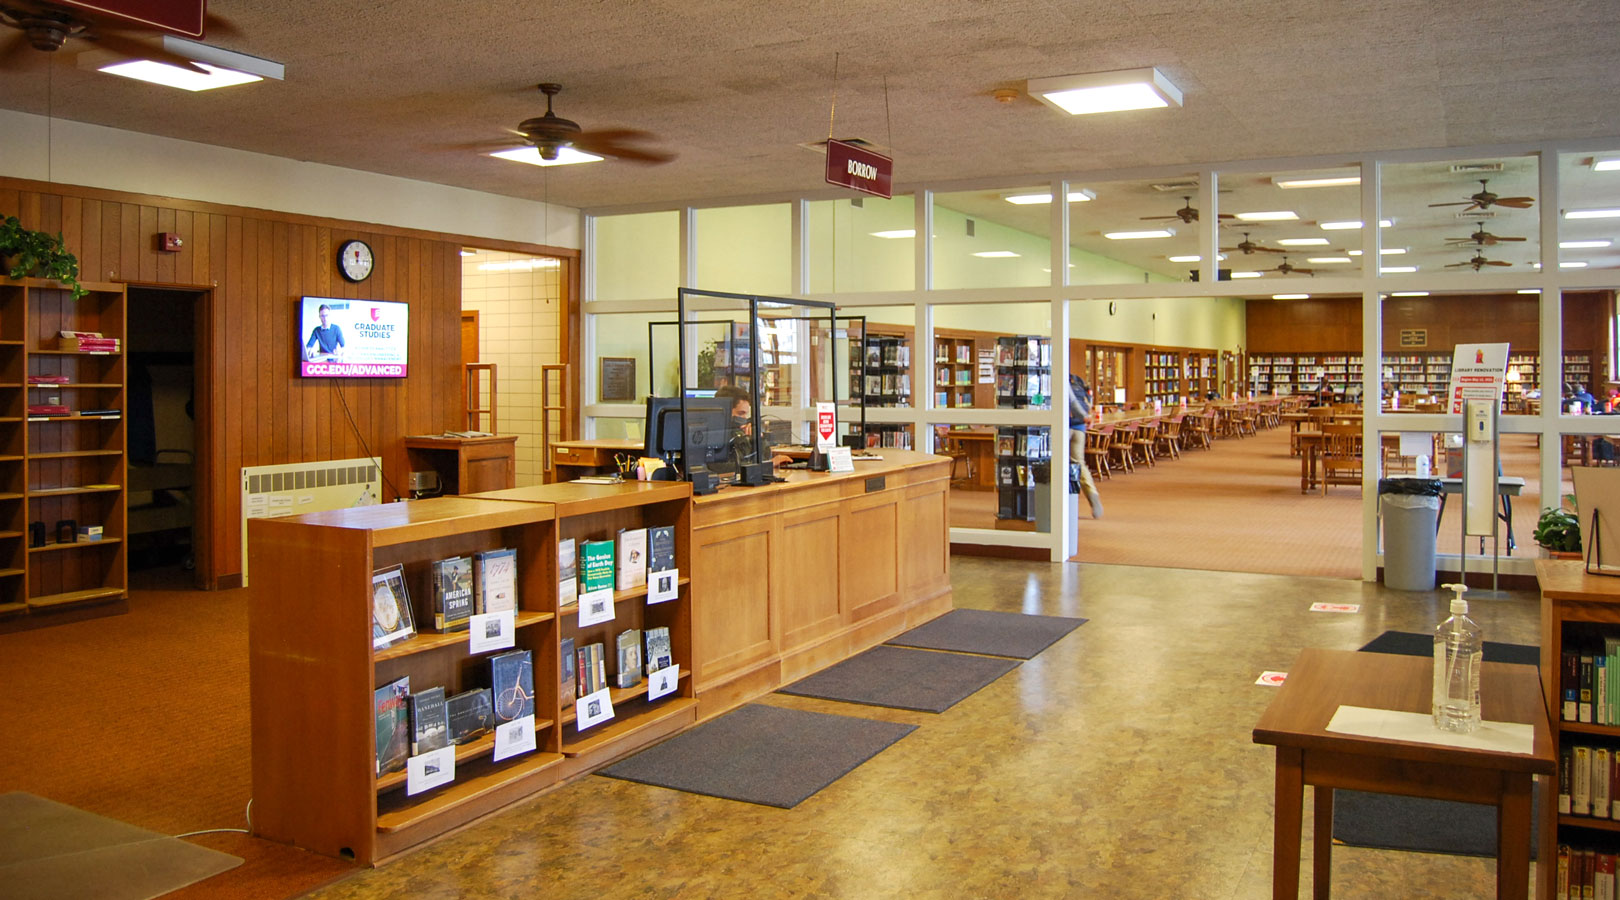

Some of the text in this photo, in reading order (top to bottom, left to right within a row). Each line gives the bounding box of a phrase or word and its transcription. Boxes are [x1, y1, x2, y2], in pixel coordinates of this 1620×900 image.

[847, 159, 878, 181] BORROW
[354, 323, 395, 331] GRADUATE
[359, 331, 391, 339] STUDIES
[306, 364, 402, 376] GCC.EDU/ADVANCED
[592, 560, 604, 568] Earth
[445, 588, 471, 600] AMERICAN
[449, 598, 469, 609] SPRING
[417, 701, 444, 712] BASEBALL
